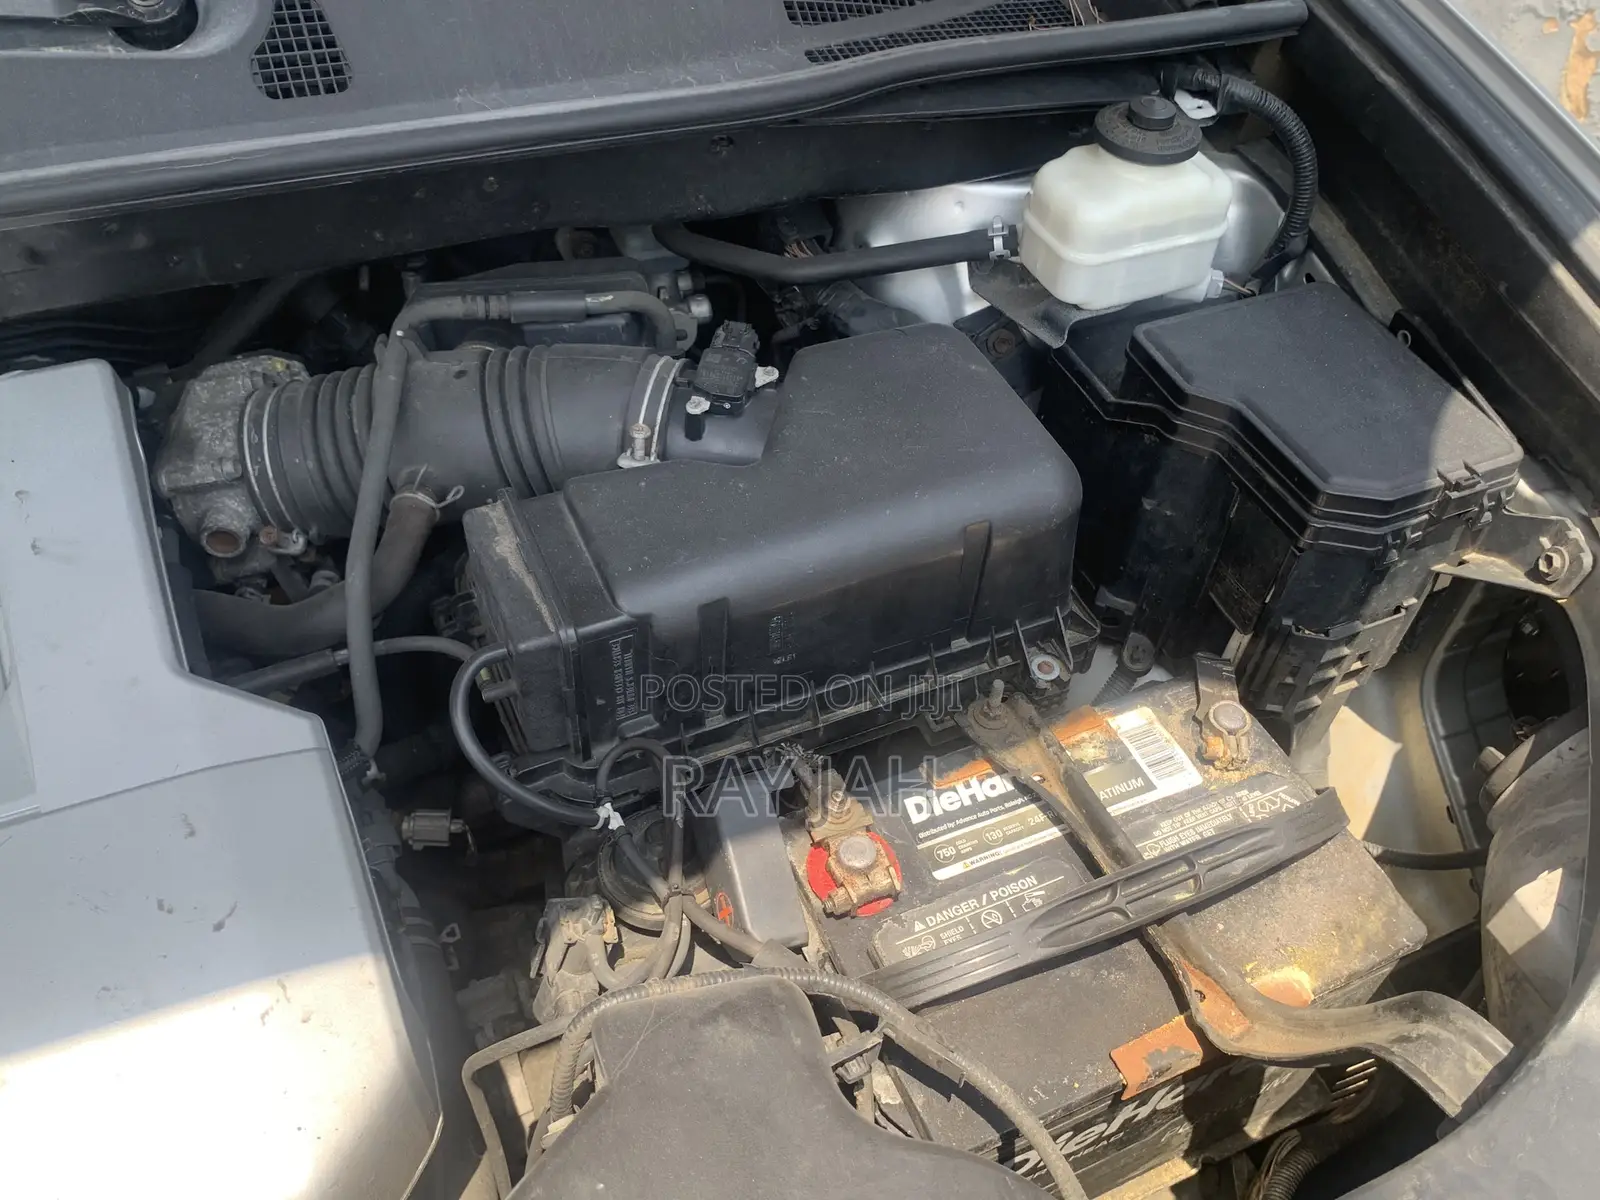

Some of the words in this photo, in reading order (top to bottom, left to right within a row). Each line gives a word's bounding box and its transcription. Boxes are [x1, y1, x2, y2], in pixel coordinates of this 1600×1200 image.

[904, 775, 1014, 824] DieHa
[1099, 777, 1145, 801] ATINUM
[918, 824, 947, 839] Distributed
[956, 814, 978, 826] Advance
[978, 809, 989, 818] Auto
[985, 829, 1003, 841] 130
[937, 845, 957, 859] 750
[925, 898, 980, 927] DANGER
[989, 875, 1038, 901] POISON
[940, 925, 965, 940] SHIELD
